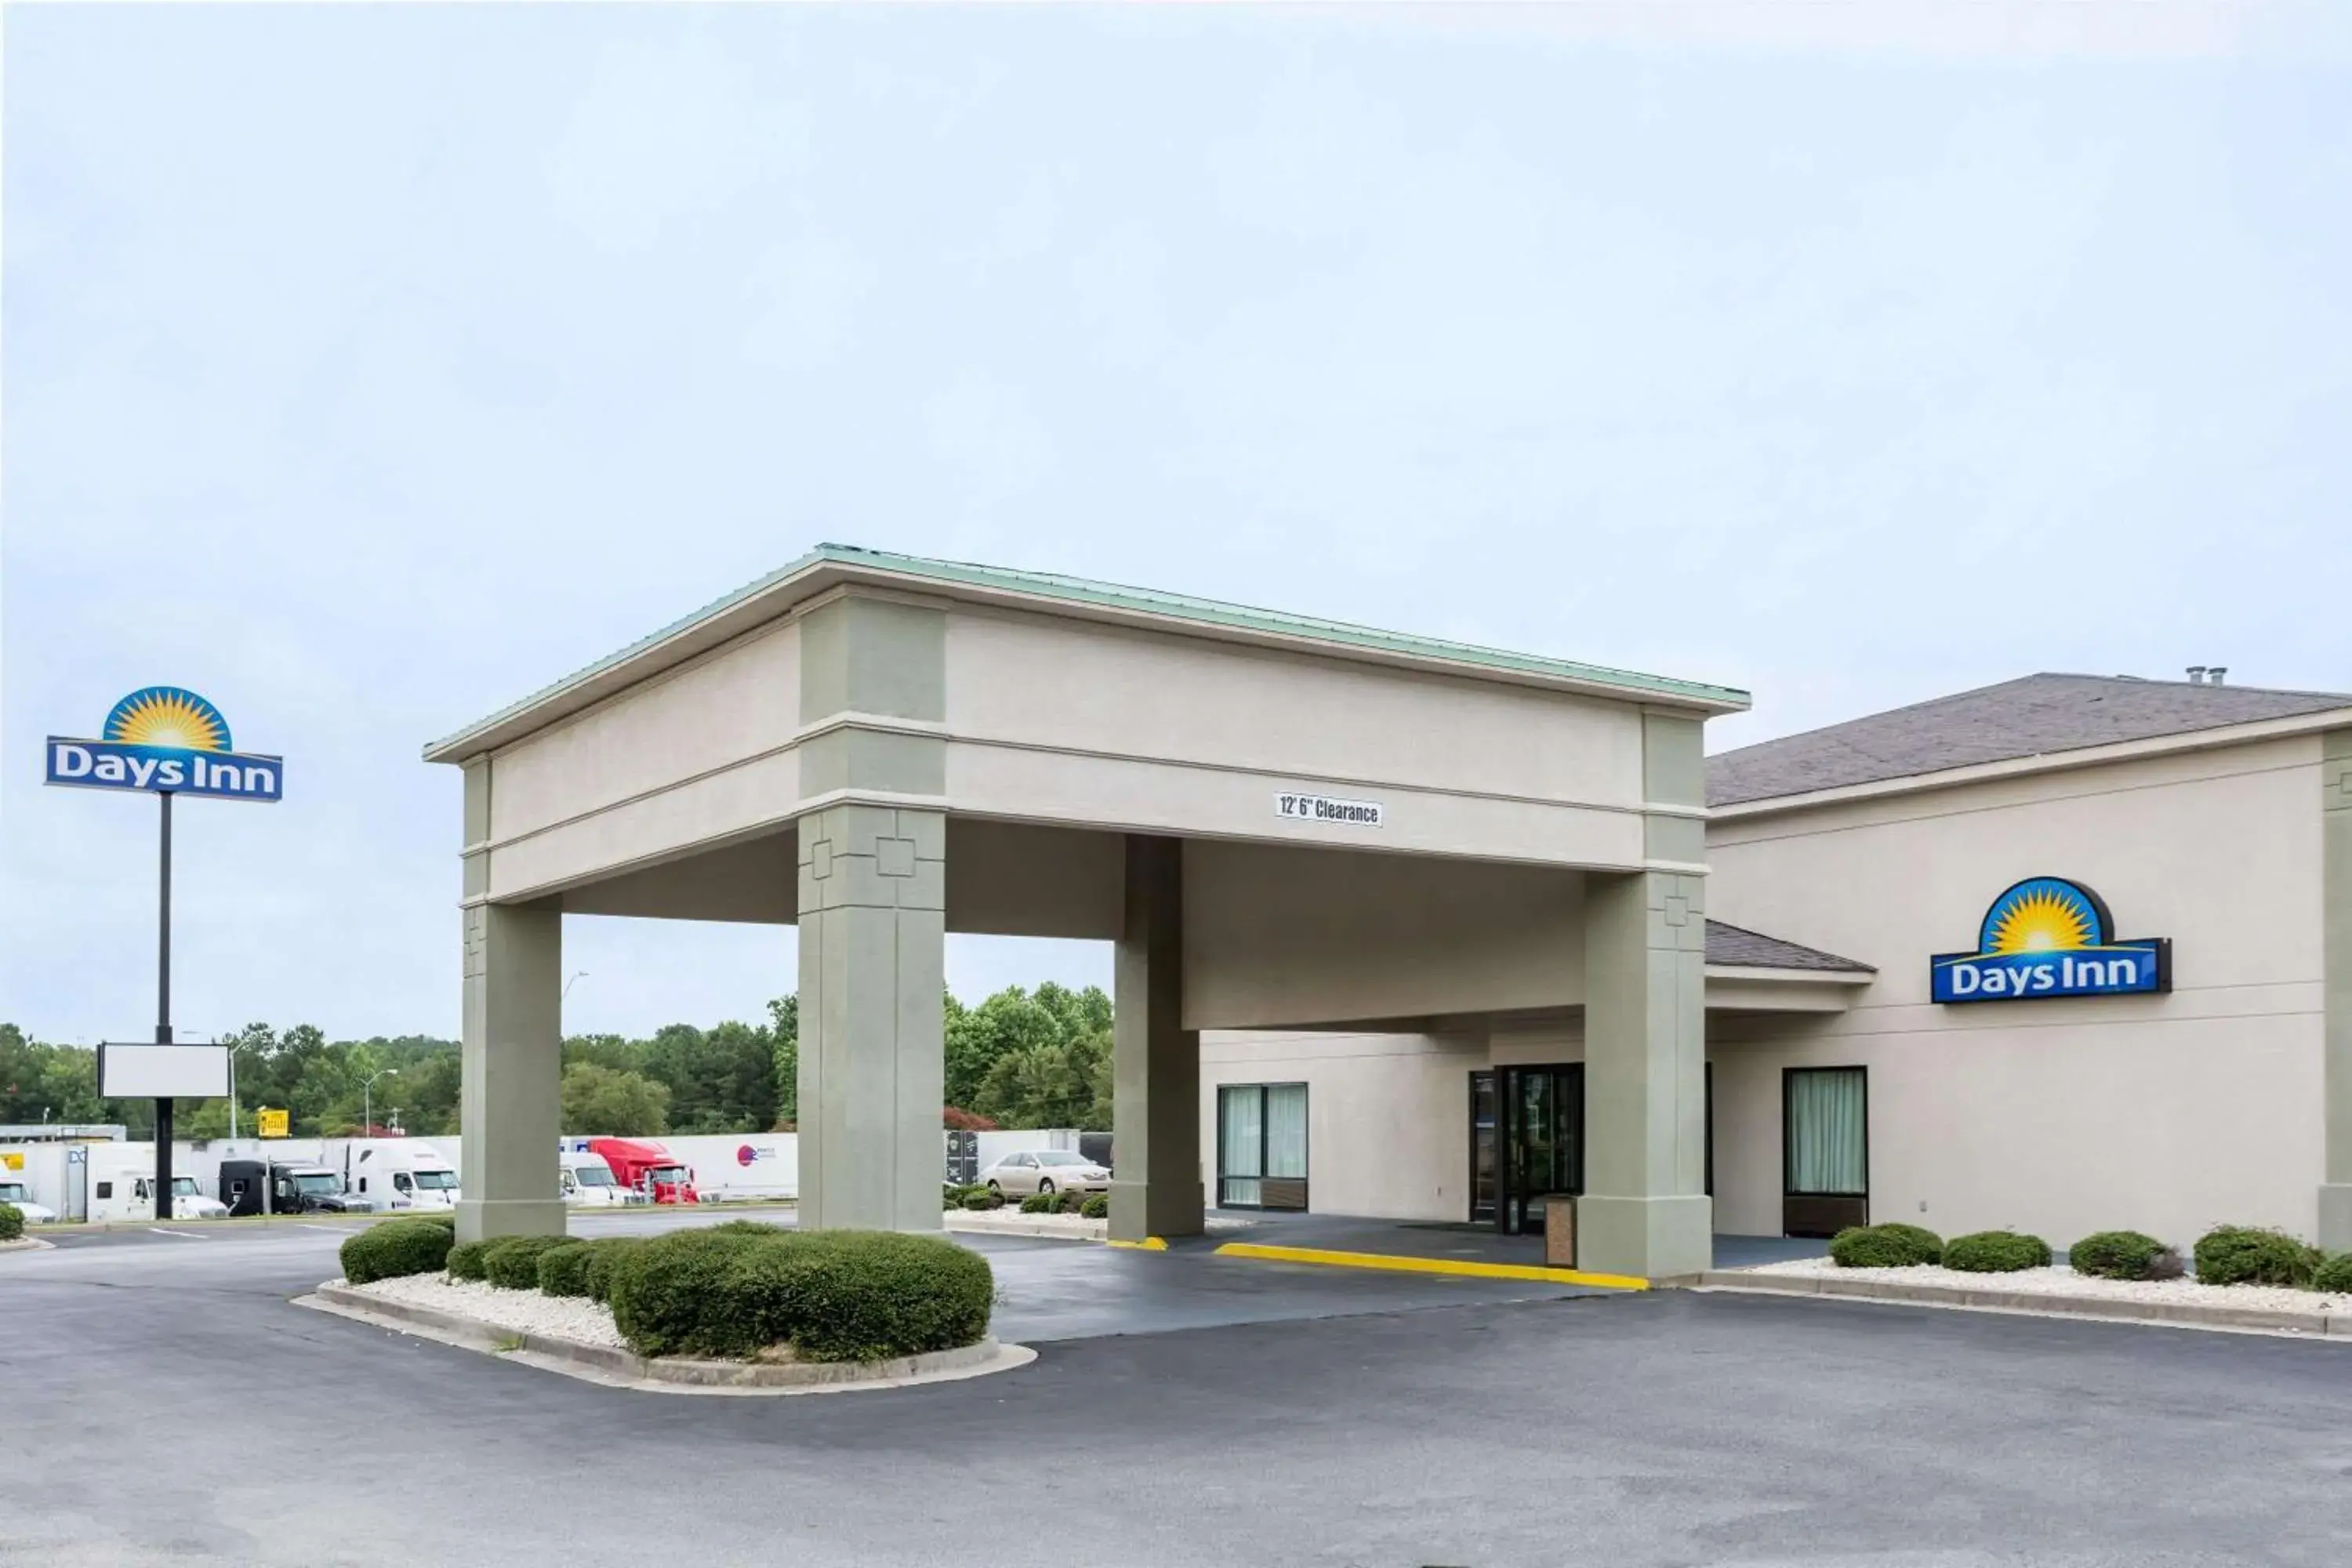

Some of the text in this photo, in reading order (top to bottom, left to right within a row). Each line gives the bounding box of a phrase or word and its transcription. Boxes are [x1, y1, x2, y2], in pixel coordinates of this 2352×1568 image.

[55, 744, 274, 793] Days Inn
[1280, 796, 1298, 815] 12'
[1316, 799, 1377, 822] Clearance
[1952, 957, 2136, 996] Days Inn
